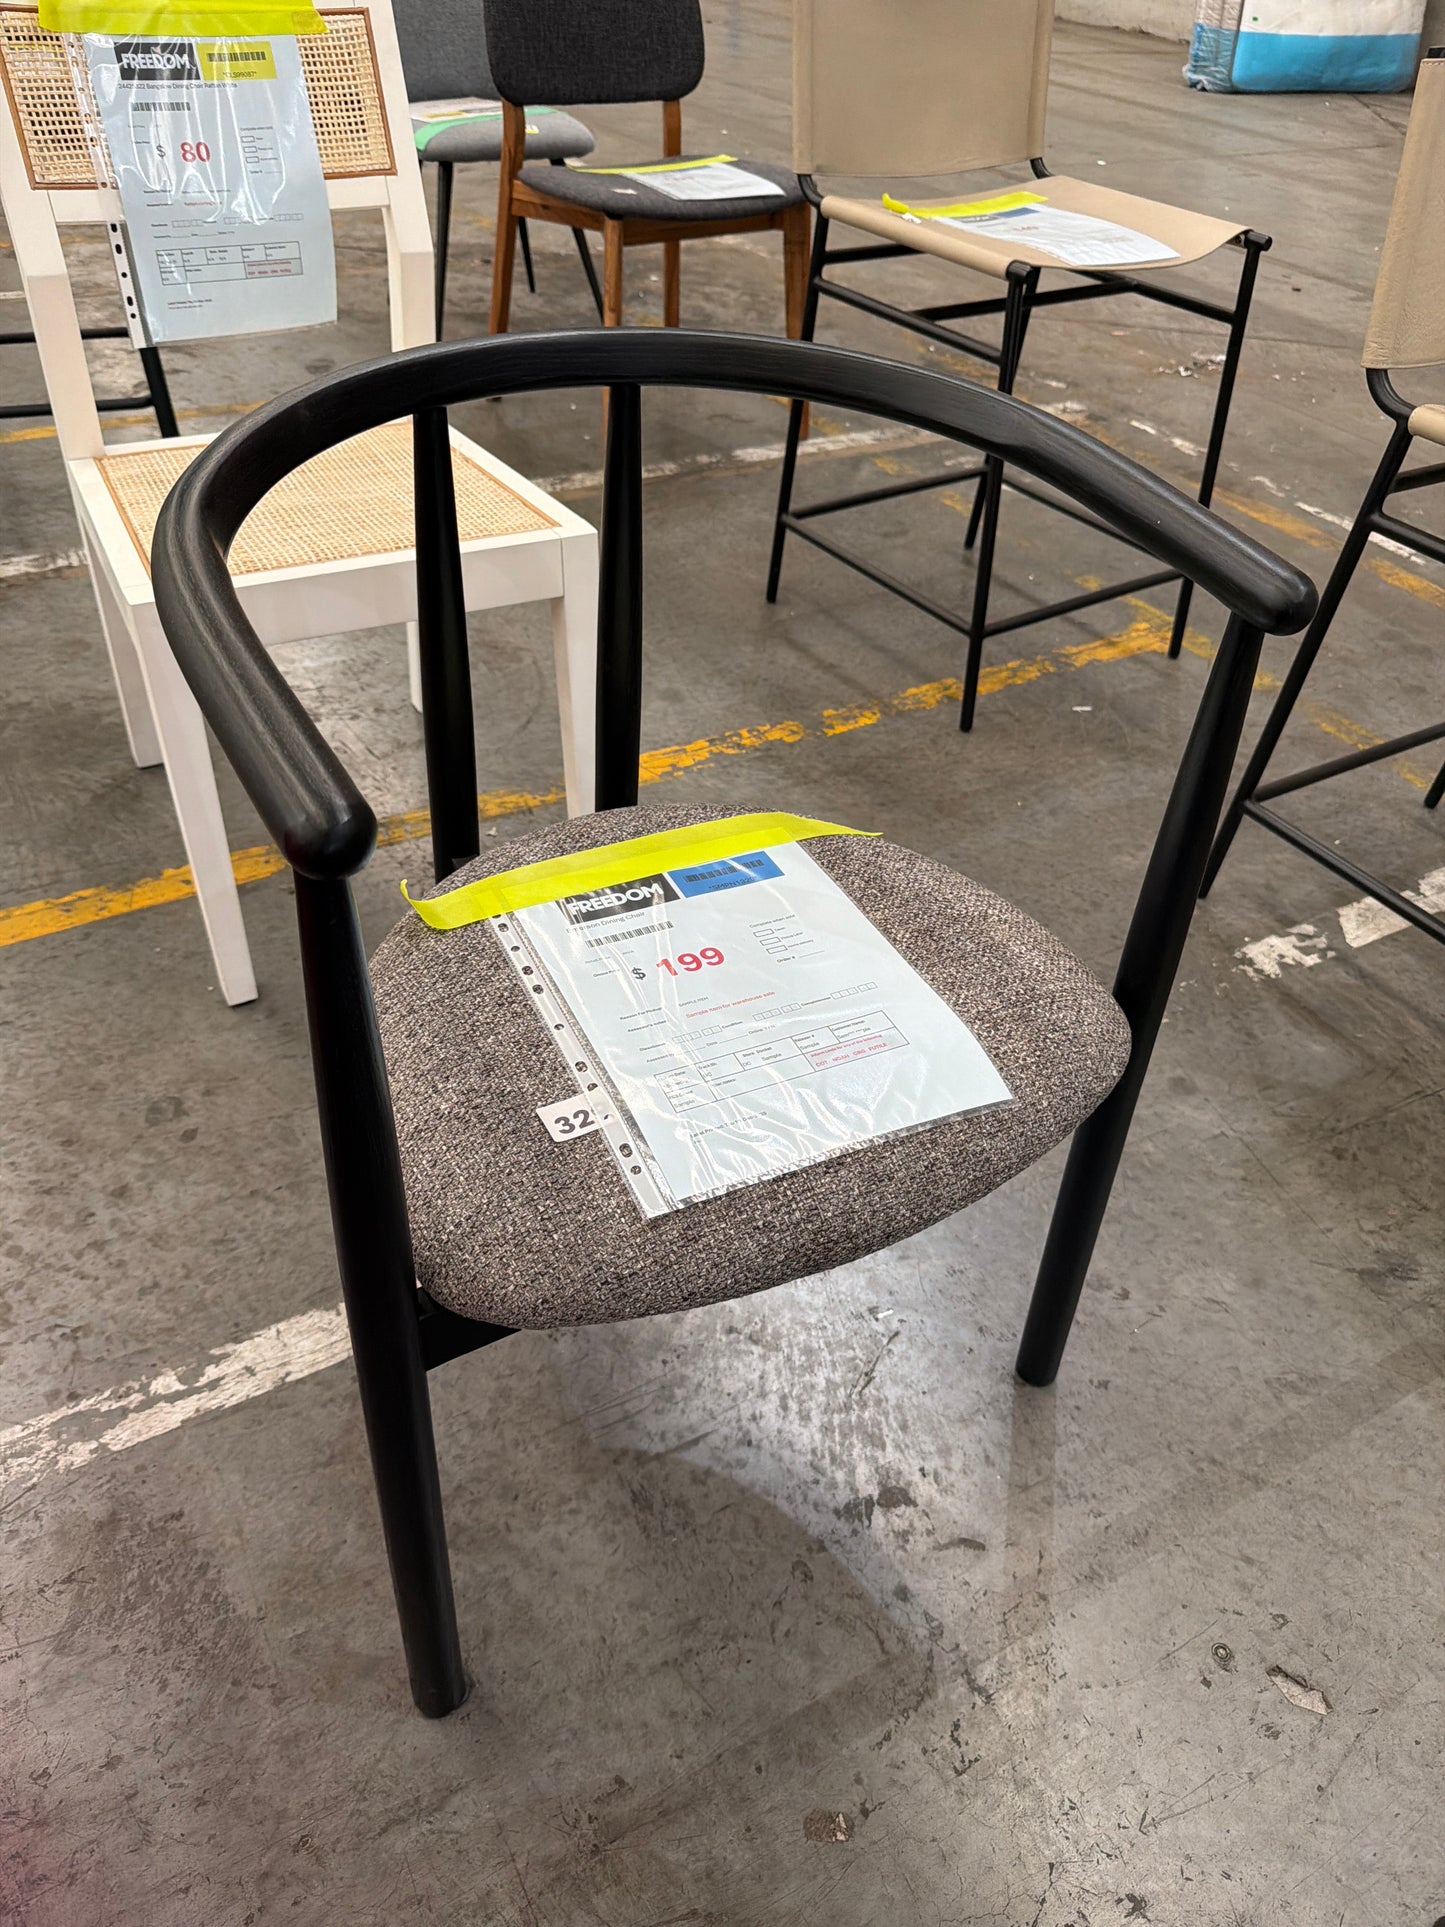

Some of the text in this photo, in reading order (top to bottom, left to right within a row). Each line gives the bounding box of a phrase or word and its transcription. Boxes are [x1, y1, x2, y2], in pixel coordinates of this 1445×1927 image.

[120, 52, 191, 70] FREEDOM
[156, 141, 211, 163] $ 80
[568, 883, 664, 915] FREEDOM
[600, 916, 626, 927] Dining
[625, 911, 645, 921] Chair
[632, 947, 725, 981] $ 199
[685, 1008, 709, 1019] Sample
[722, 1002, 731, 1010] for
[731, 994, 763, 1007] warehouse
[554, 1109, 596, 1135] 32
